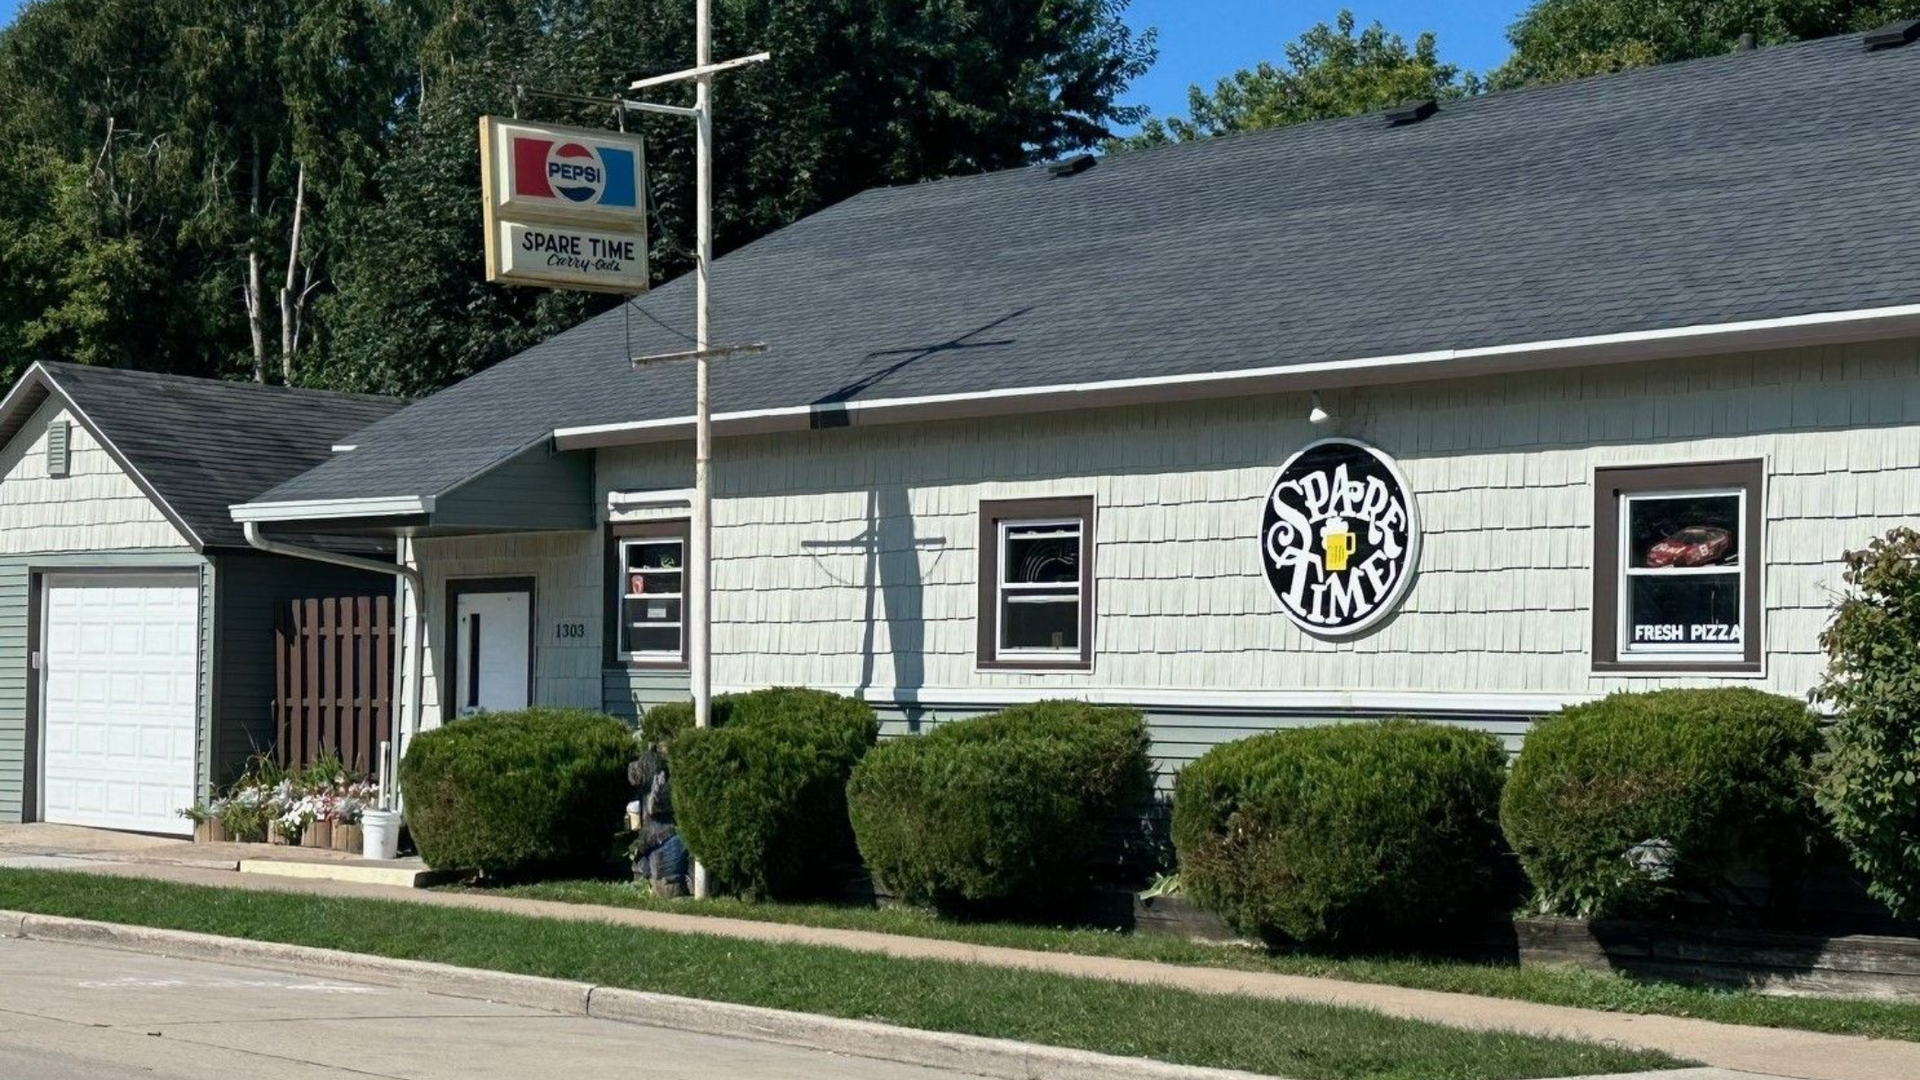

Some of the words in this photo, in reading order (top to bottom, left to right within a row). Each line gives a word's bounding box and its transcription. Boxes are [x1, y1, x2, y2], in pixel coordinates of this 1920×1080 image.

[549, 162, 600, 183] PEPSI
[522, 231, 581, 255] SPARE
[589, 238, 635, 261] TIME
[1267, 463, 1406, 568] SPARE
[1279, 546, 1396, 624] TIME
[556, 624, 585, 638] 1303
[1635, 624, 1684, 641] FRESH
[1691, 624, 1741, 641] PIZZA
